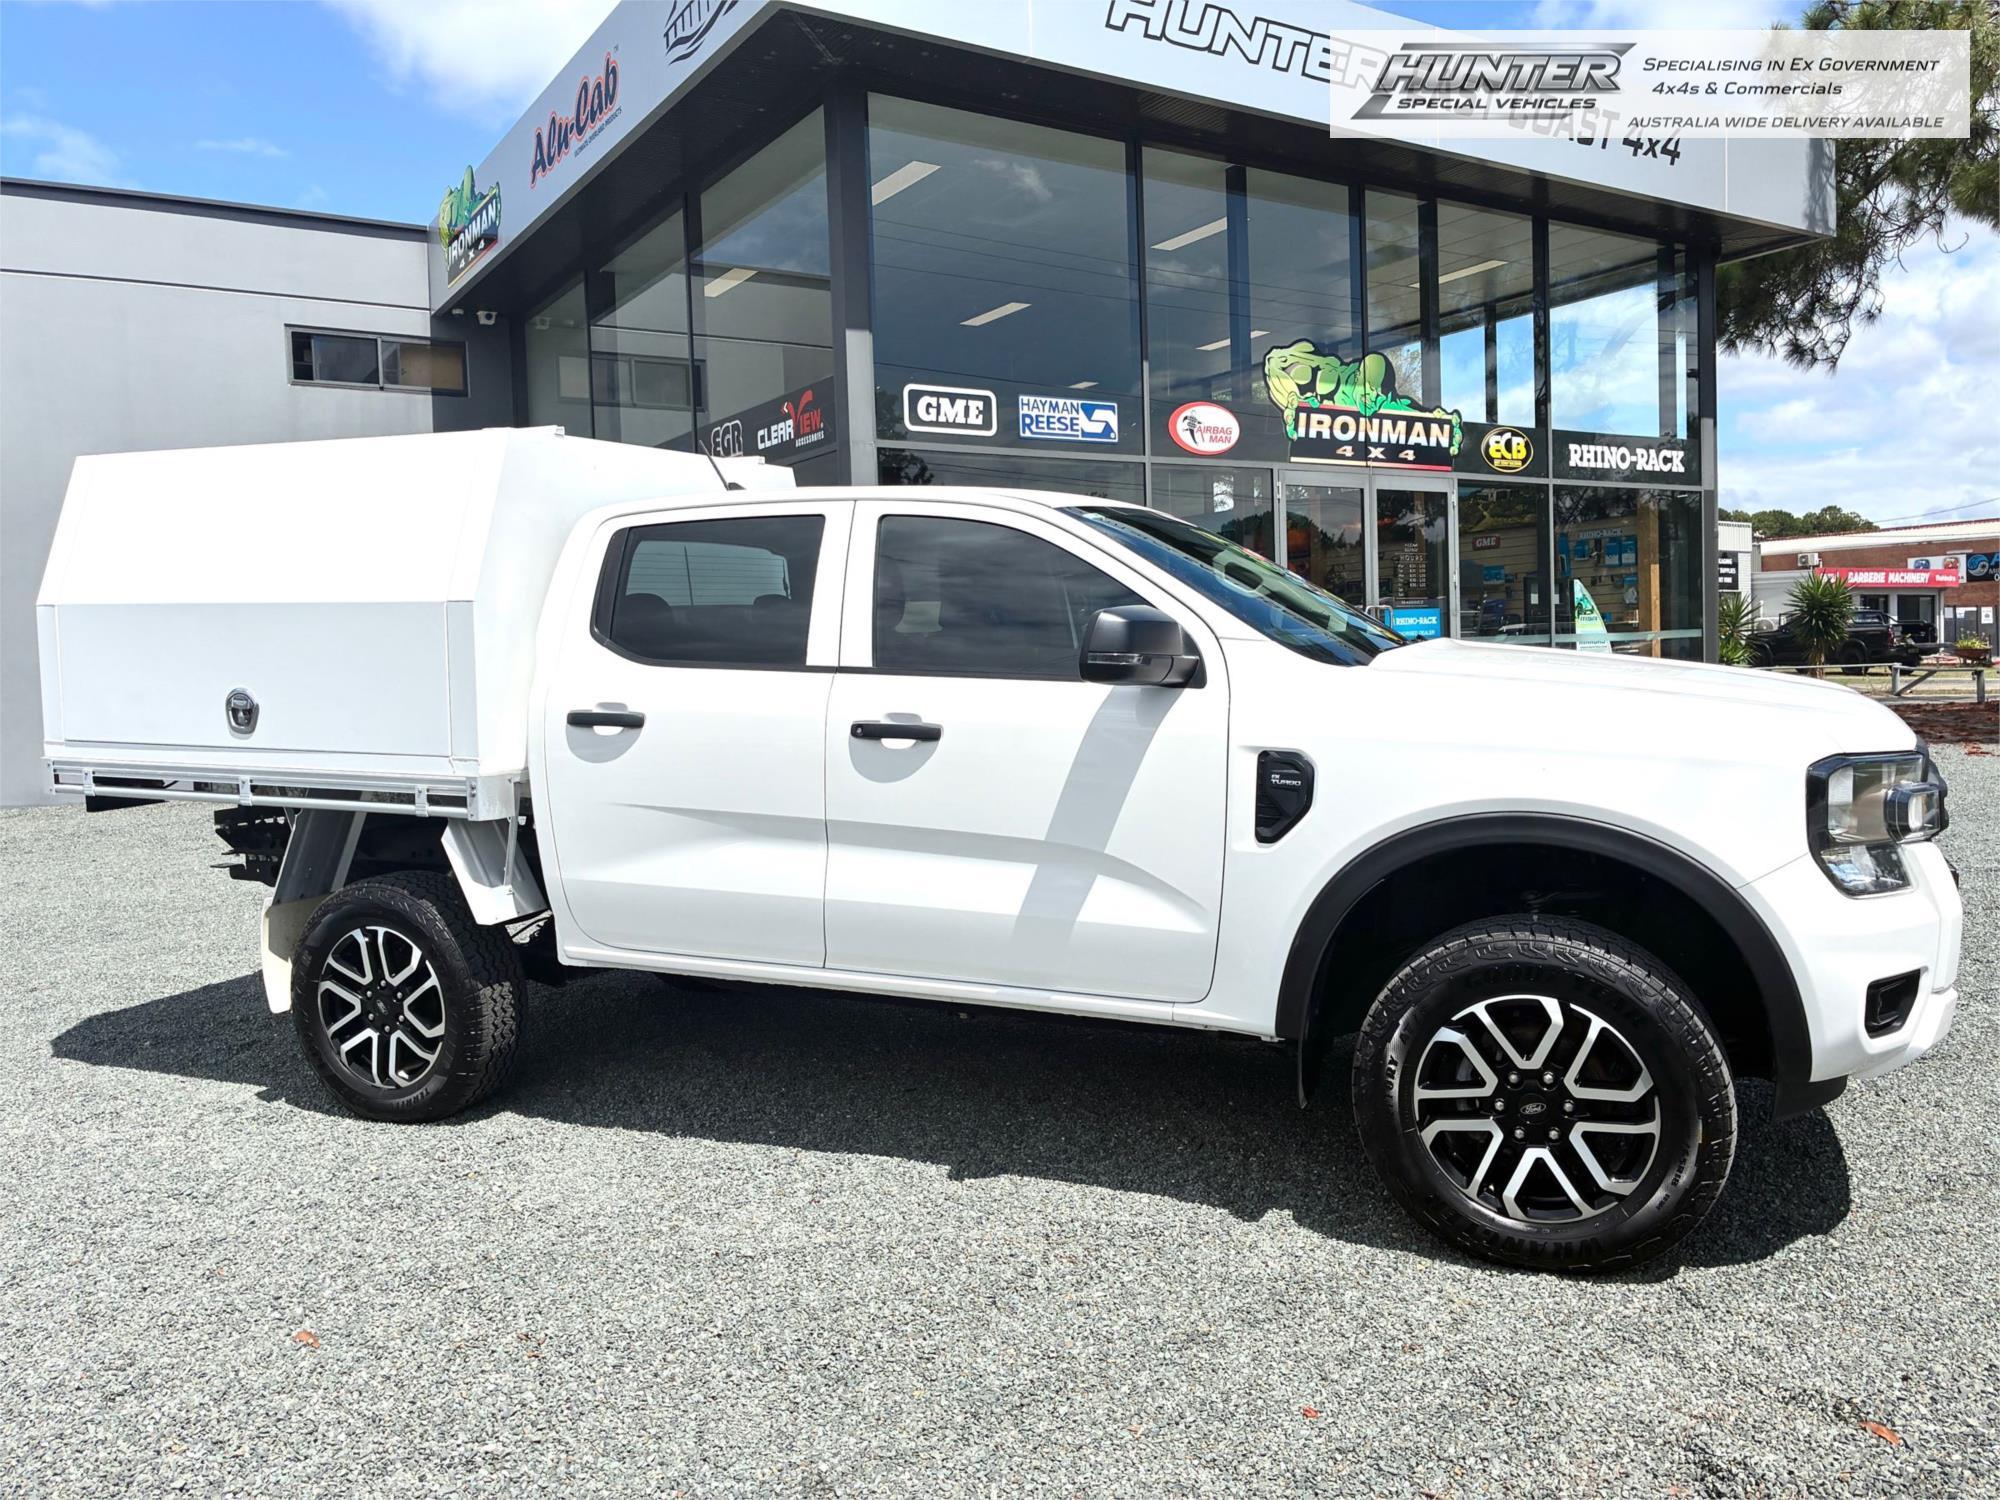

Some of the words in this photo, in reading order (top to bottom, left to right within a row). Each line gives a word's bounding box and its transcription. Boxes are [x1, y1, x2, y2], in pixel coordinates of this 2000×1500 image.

[1105, 0, 1390, 93] HUNTER
[530, 52, 619, 188] Alu-Cab
[448, 198, 496, 268] IRONMAN
[459, 258, 465, 268] 4
[478, 239, 485, 250] 4
[917, 395, 984, 425] GME
[1021, 398, 1080, 415] HAYMAN
[1021, 413, 1080, 435] REESE
[1196, 425, 1233, 437] AIRBAG
[1297, 412, 1451, 448] IRONMAN
[711, 420, 743, 457] EGR
[795, 430, 824, 447] ACCESSORIES
[1209, 434, 1232, 444] MAN
[1488, 431, 1527, 460] ECB
[1336, 445, 1354, 457] 4
[1398, 449, 1416, 461] 4
[1568, 443, 1685, 473] RHINO-RACK
[1476, 537, 1497, 547] GME
[1848, 571, 1885, 583] BARBERIE
[1888, 571, 1930, 584] MACHINERY
[1396, 616, 1437, 625] RHINO-RACK
